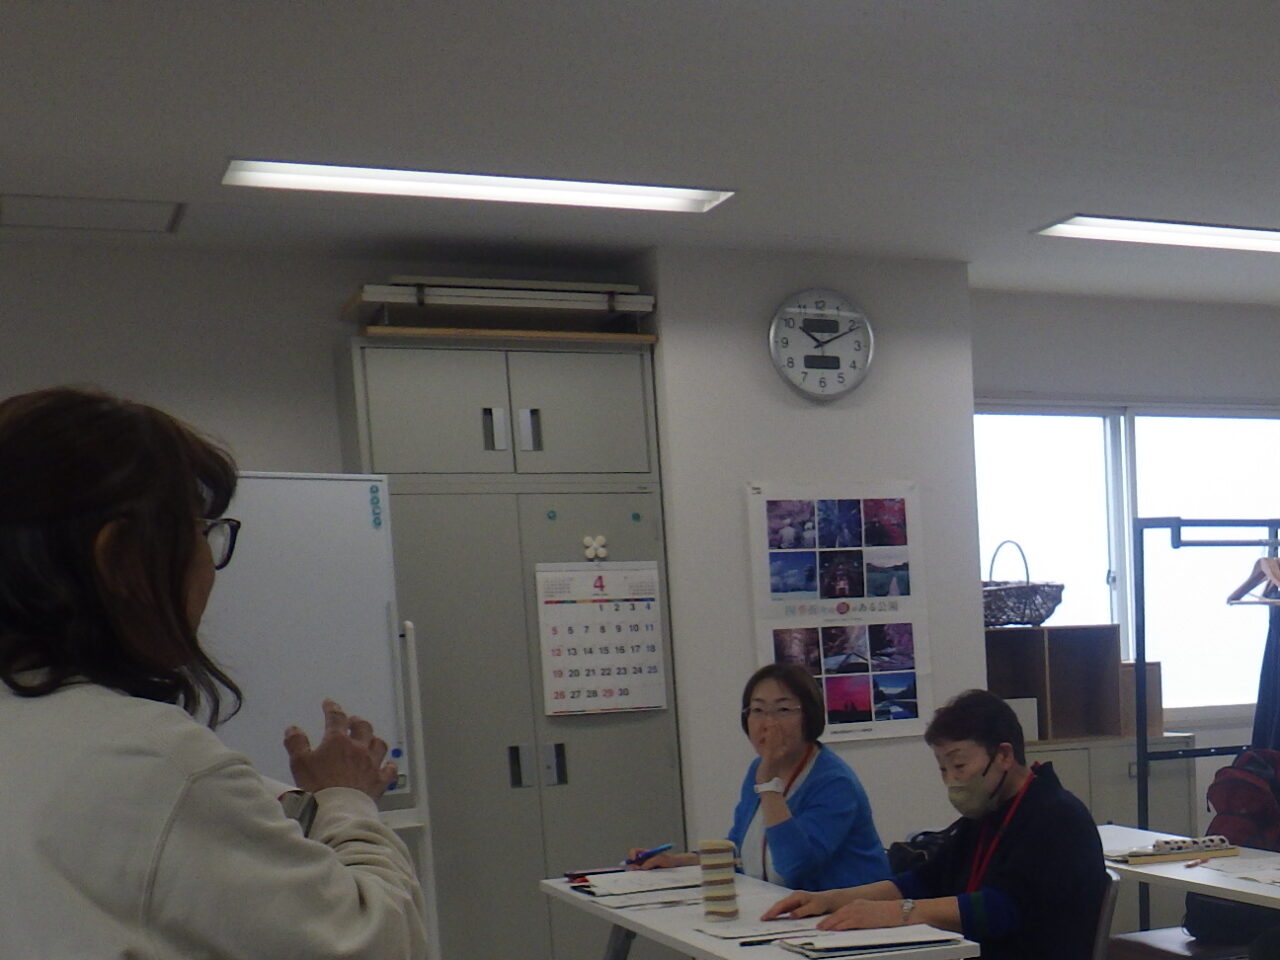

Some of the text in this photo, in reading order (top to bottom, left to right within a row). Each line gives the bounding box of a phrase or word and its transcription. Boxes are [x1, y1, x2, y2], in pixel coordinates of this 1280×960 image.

[784, 318, 795, 328] 10
[848, 320, 856, 331] 2
[781, 337, 789, 348] 9
[854, 341, 861, 351] 3
[787, 357, 794, 368] 8
[849, 360, 856, 370] 4
[801, 372, 808, 382] 7
[819, 377, 827, 388] 6
[837, 373, 845, 383] 5
[593, 575, 605, 591] 4
[552, 627, 558, 635] 5
[584, 626, 589, 634] 7
[629, 624, 639, 632] 10
[615, 646, 625, 654] 16
[631, 645, 640, 653] 17
[646, 645, 656, 653] 18
[553, 670, 563, 678] 19
[568, 669, 580, 677] 20
[600, 668, 611, 676] 22
[647, 666, 658, 674] 25
[554, 688, 629, 699] 26 27 28 29 30
